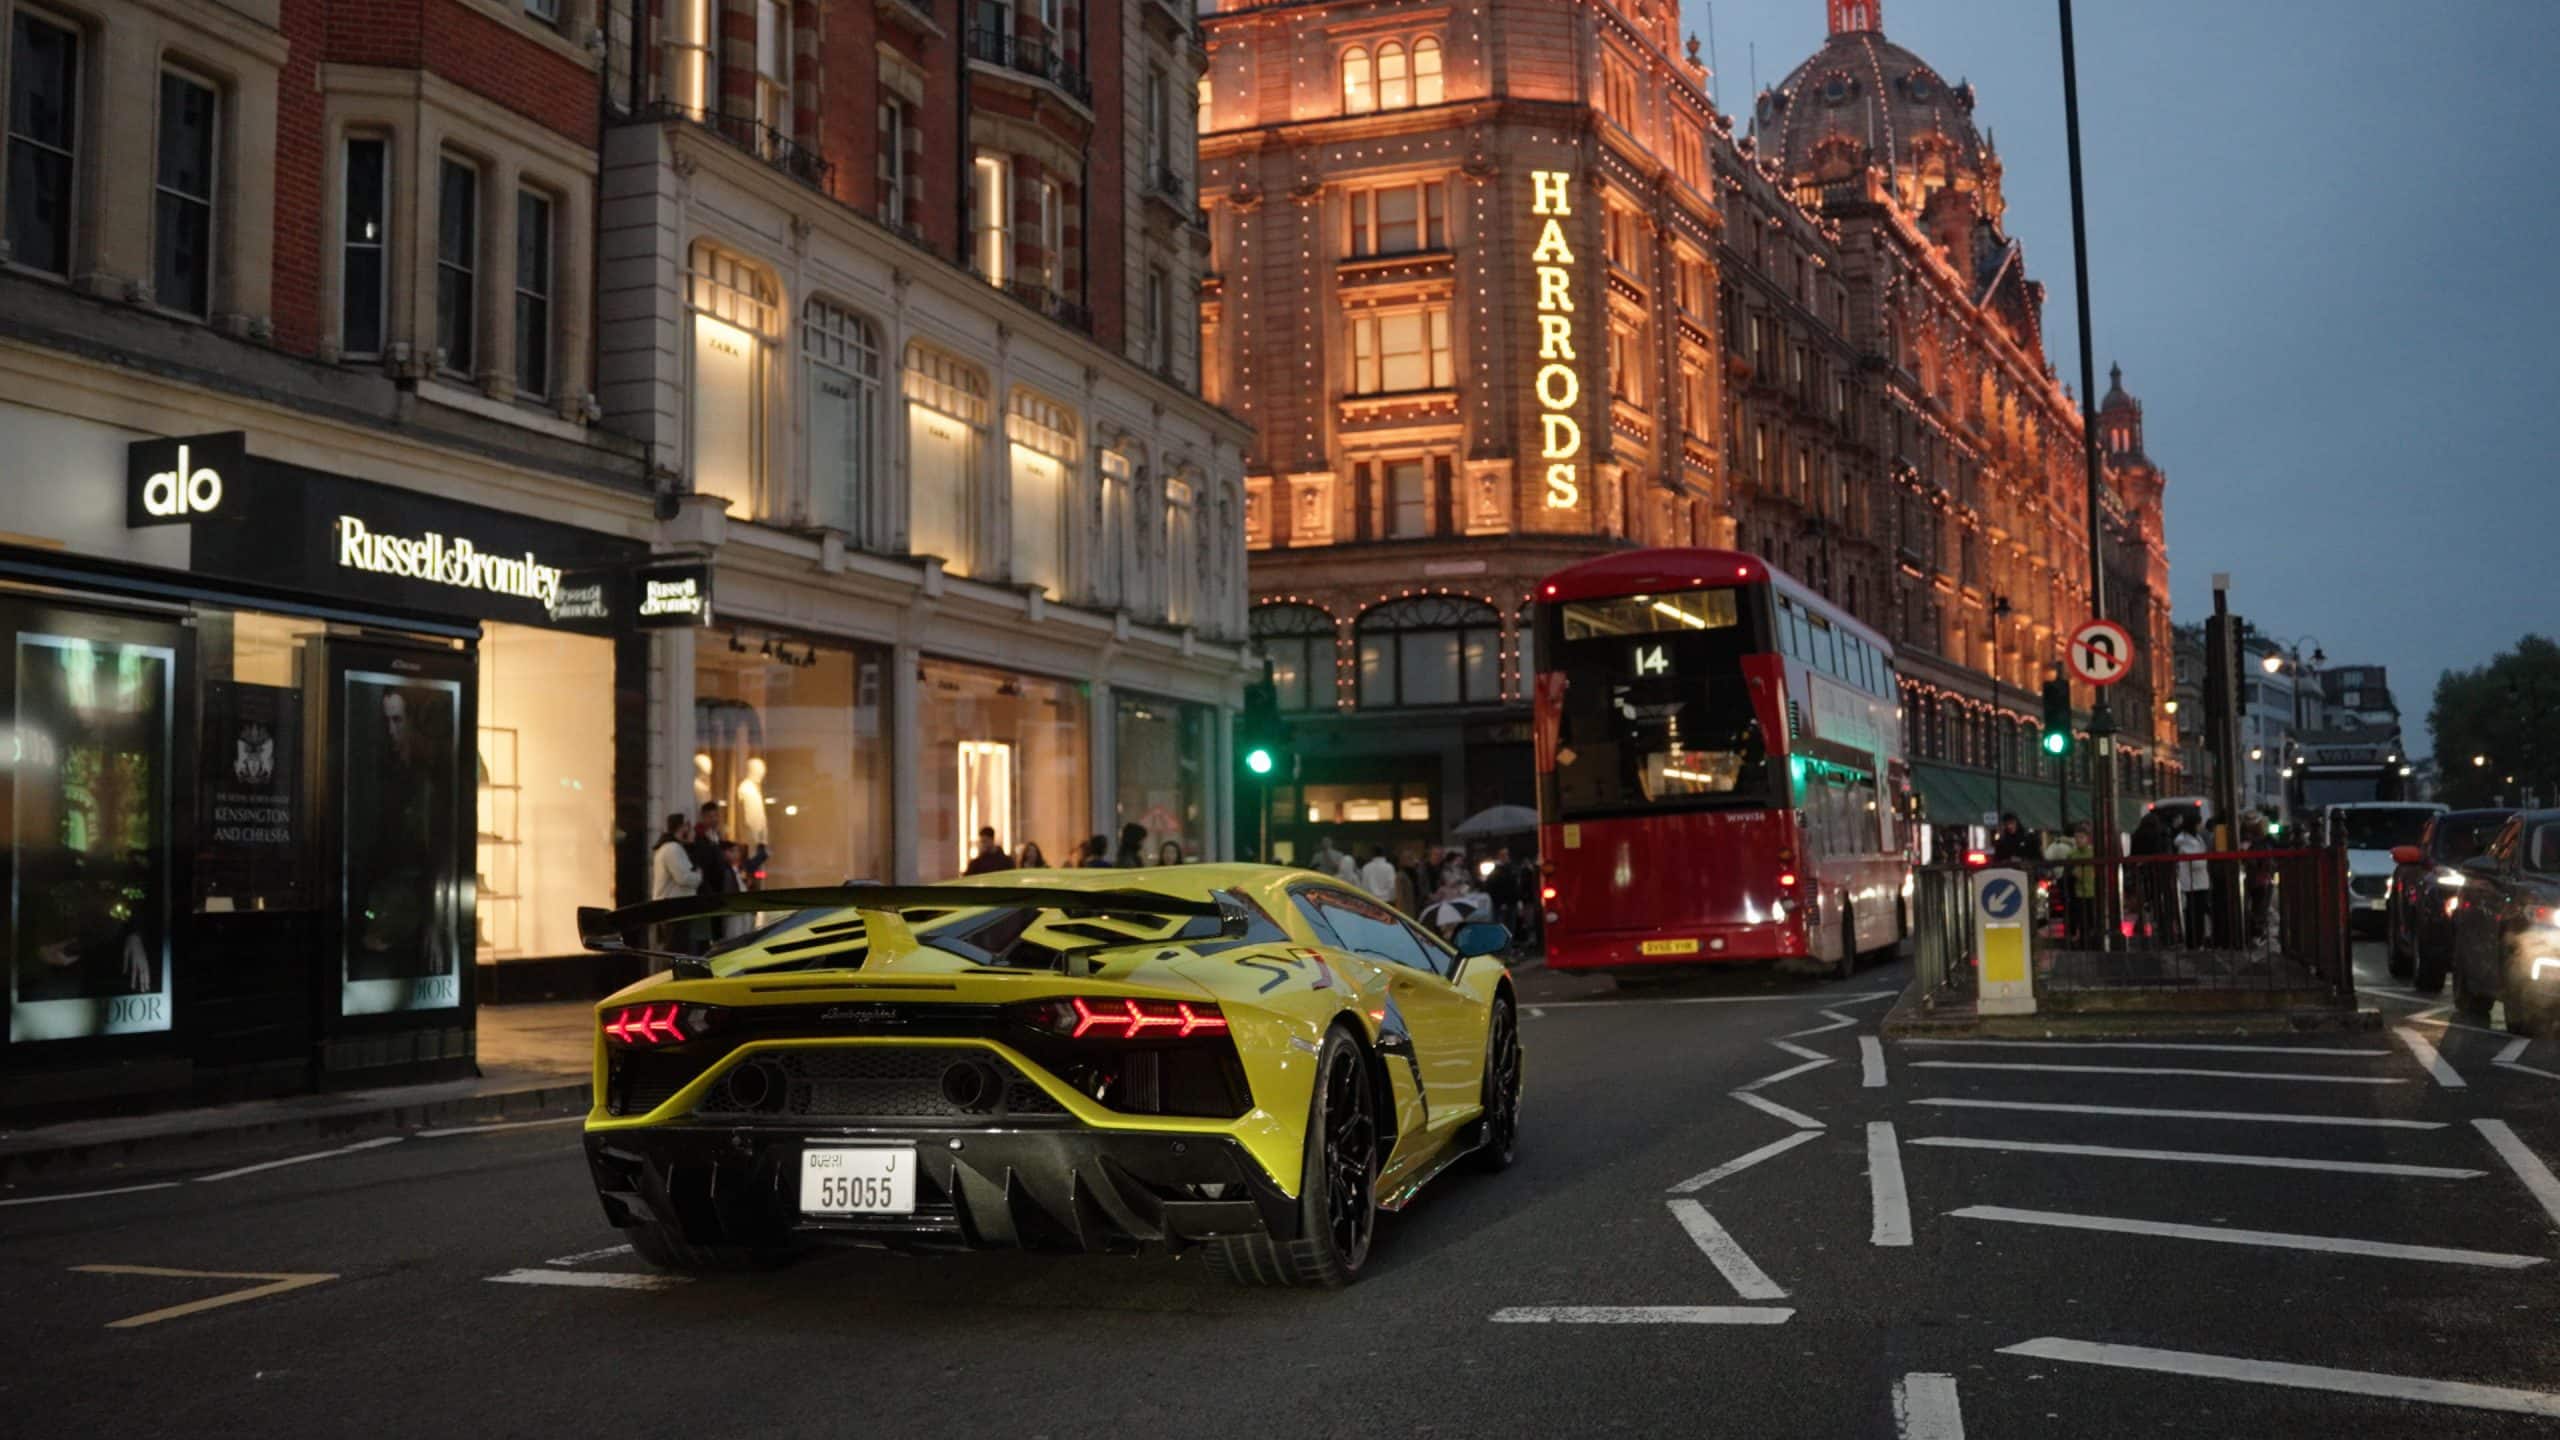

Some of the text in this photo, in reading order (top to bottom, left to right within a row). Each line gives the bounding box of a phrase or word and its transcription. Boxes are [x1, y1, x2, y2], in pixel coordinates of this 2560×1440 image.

[1531, 171, 1581, 509] HARRODS
[143, 445, 222, 516] alo
[1635, 645, 1669, 677] 14
[215, 807, 290, 824] KENSINGTON
[214, 827, 290, 843] AND CHELSEA
[886, 1154, 896, 1173] J
[821, 1177, 892, 1208] 55055
